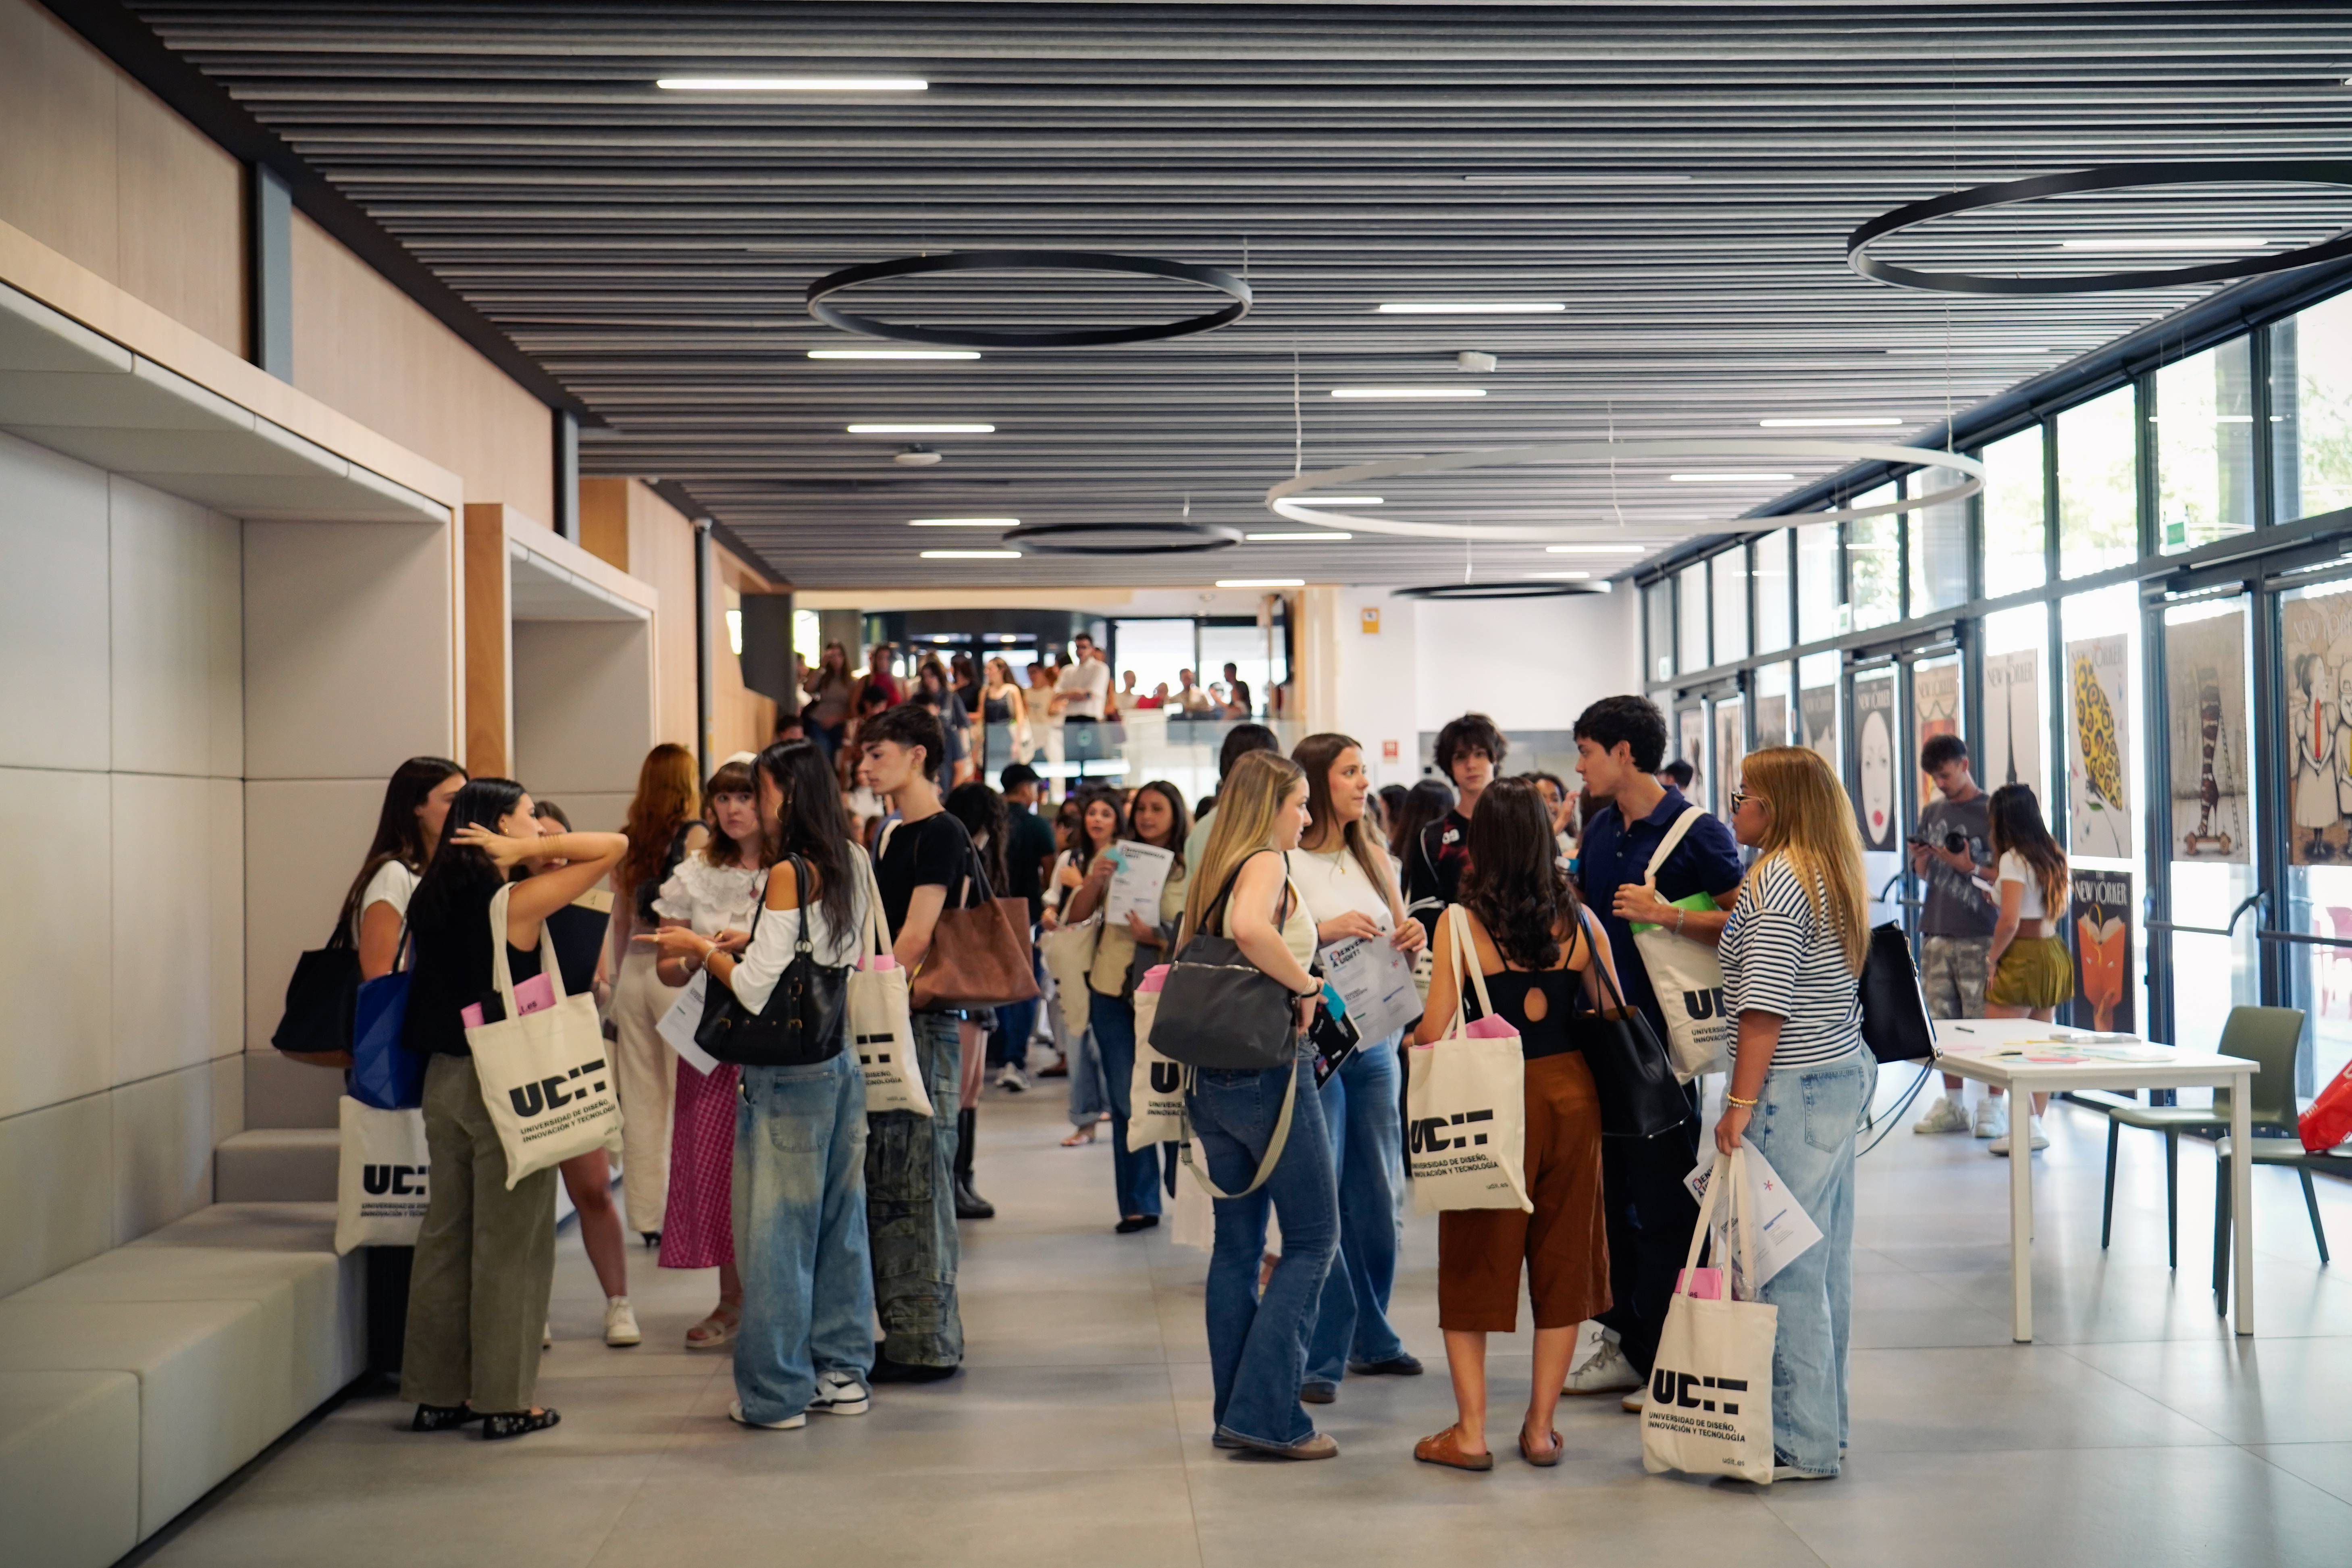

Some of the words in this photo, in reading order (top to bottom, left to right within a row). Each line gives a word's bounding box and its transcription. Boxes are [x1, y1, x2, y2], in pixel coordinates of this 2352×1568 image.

[2075, 880, 2093, 903] NEW
[2093, 881, 2127, 906] YORKER
[509, 1058, 606, 1117] UDIT
[520, 1113, 572, 1134] UNIVERSIDAD
[572, 1109, 582, 1117] DE
[1411, 1109, 1493, 1154] UDIT
[1455, 1161, 1499, 1173] TECNOLOGÍA
[1460, 1154, 1489, 1164] DISEÑO,
[364, 1163, 430, 1196] UDI
[1653, 1368, 1747, 1416] UDIT
[1648, 1420, 1691, 1434] INNOVACIÓN
[1699, 1428, 1745, 1442] TECNOLOGÍA
[1649, 1412, 1694, 1425] UNIVERSIDAD
[1707, 1421, 1736, 1433] DISEÑO,
